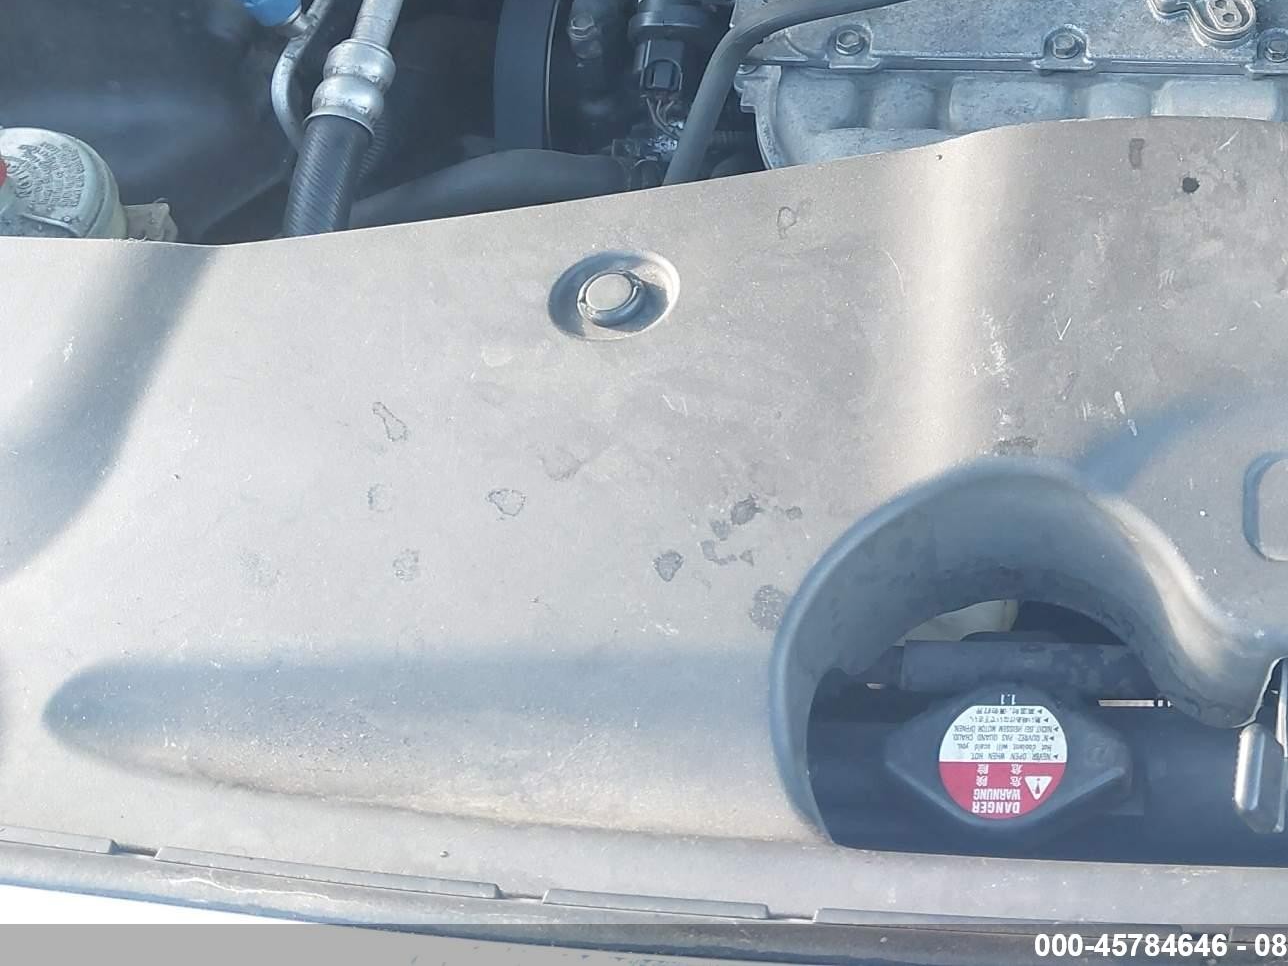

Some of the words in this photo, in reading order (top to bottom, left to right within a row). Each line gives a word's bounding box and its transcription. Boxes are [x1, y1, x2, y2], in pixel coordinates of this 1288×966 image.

[1000, 694, 1016, 704] 1.1
[988, 752, 1004, 760] WHEN
[1011, 752, 1027, 760] OPEN
[974, 789, 1020, 800] WARNUNG
[972, 802, 1020, 813] DANGER
